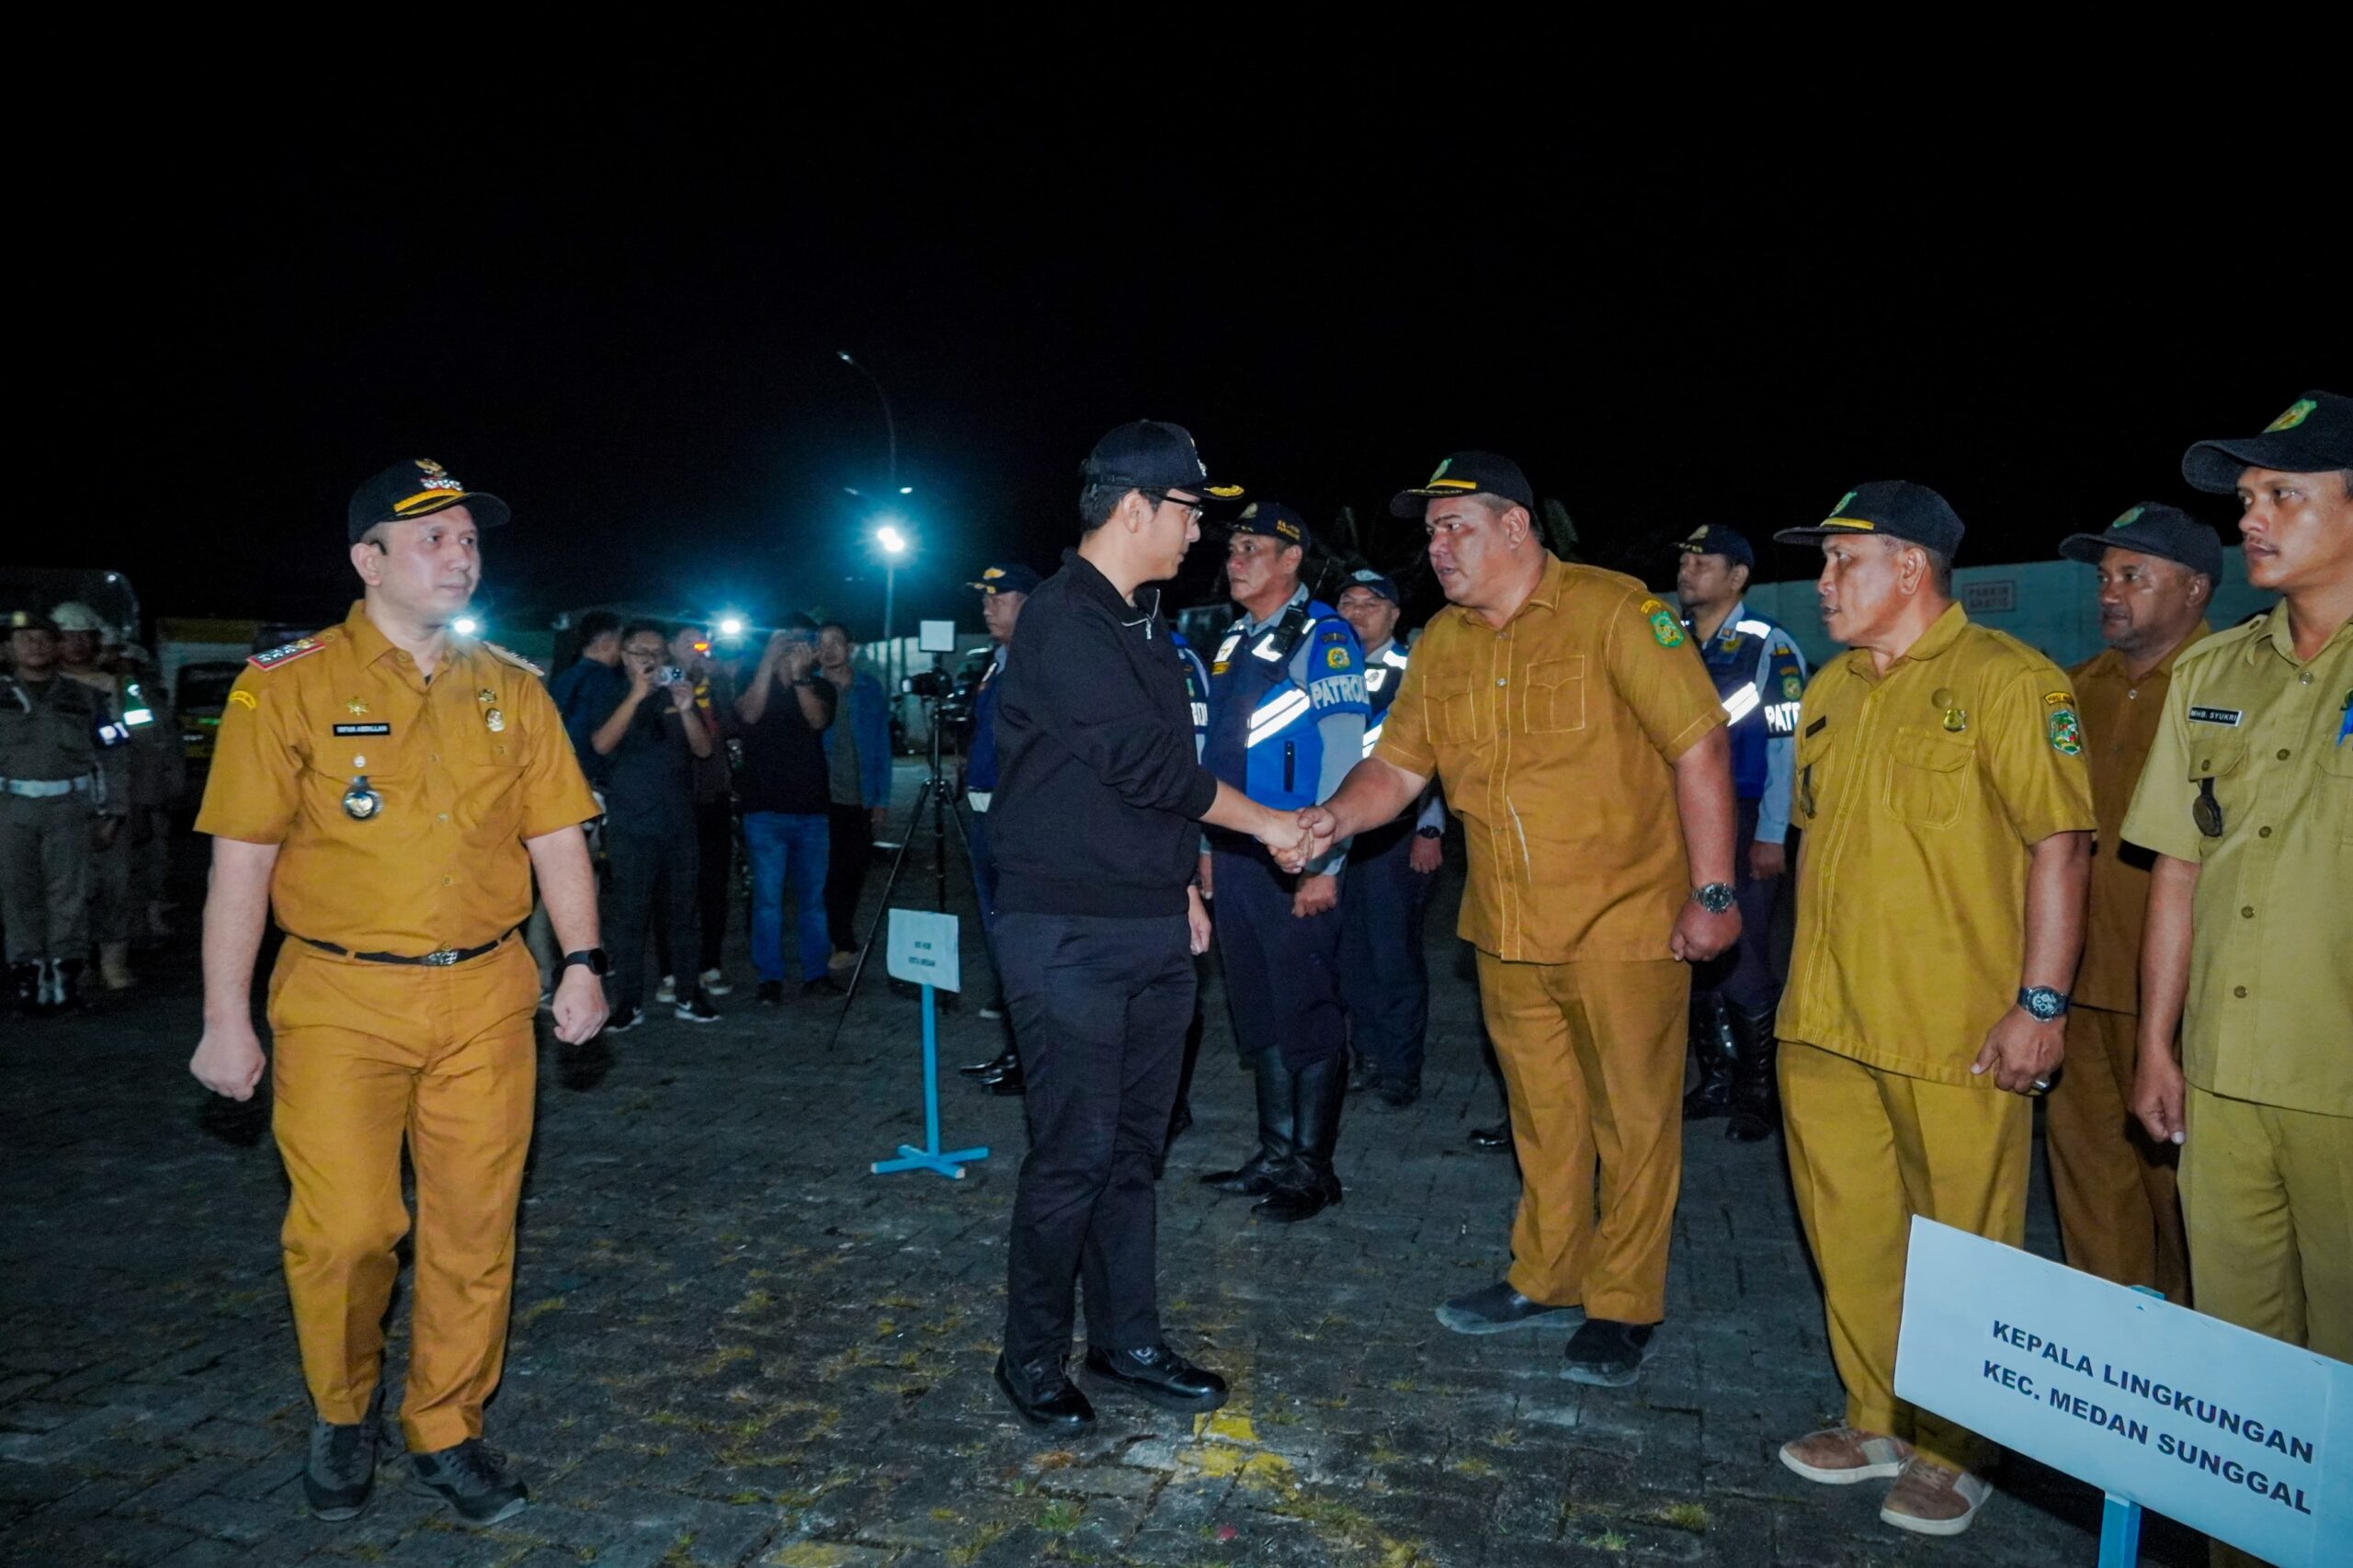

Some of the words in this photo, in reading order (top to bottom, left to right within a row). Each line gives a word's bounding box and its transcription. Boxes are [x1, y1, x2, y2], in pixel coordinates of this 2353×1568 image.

[1310, 676, 1370, 710] PATROL
[2210, 712, 2237, 722] SYUKRI
[1993, 1320, 2094, 1378] KEPALA
[2104, 1365, 2313, 1464] LINGKUNGAN
[1984, 1360, 2040, 1401] KEC.
[2050, 1388, 2149, 1445] MEDAN
[2157, 1433, 2312, 1516] SUNGGAL
